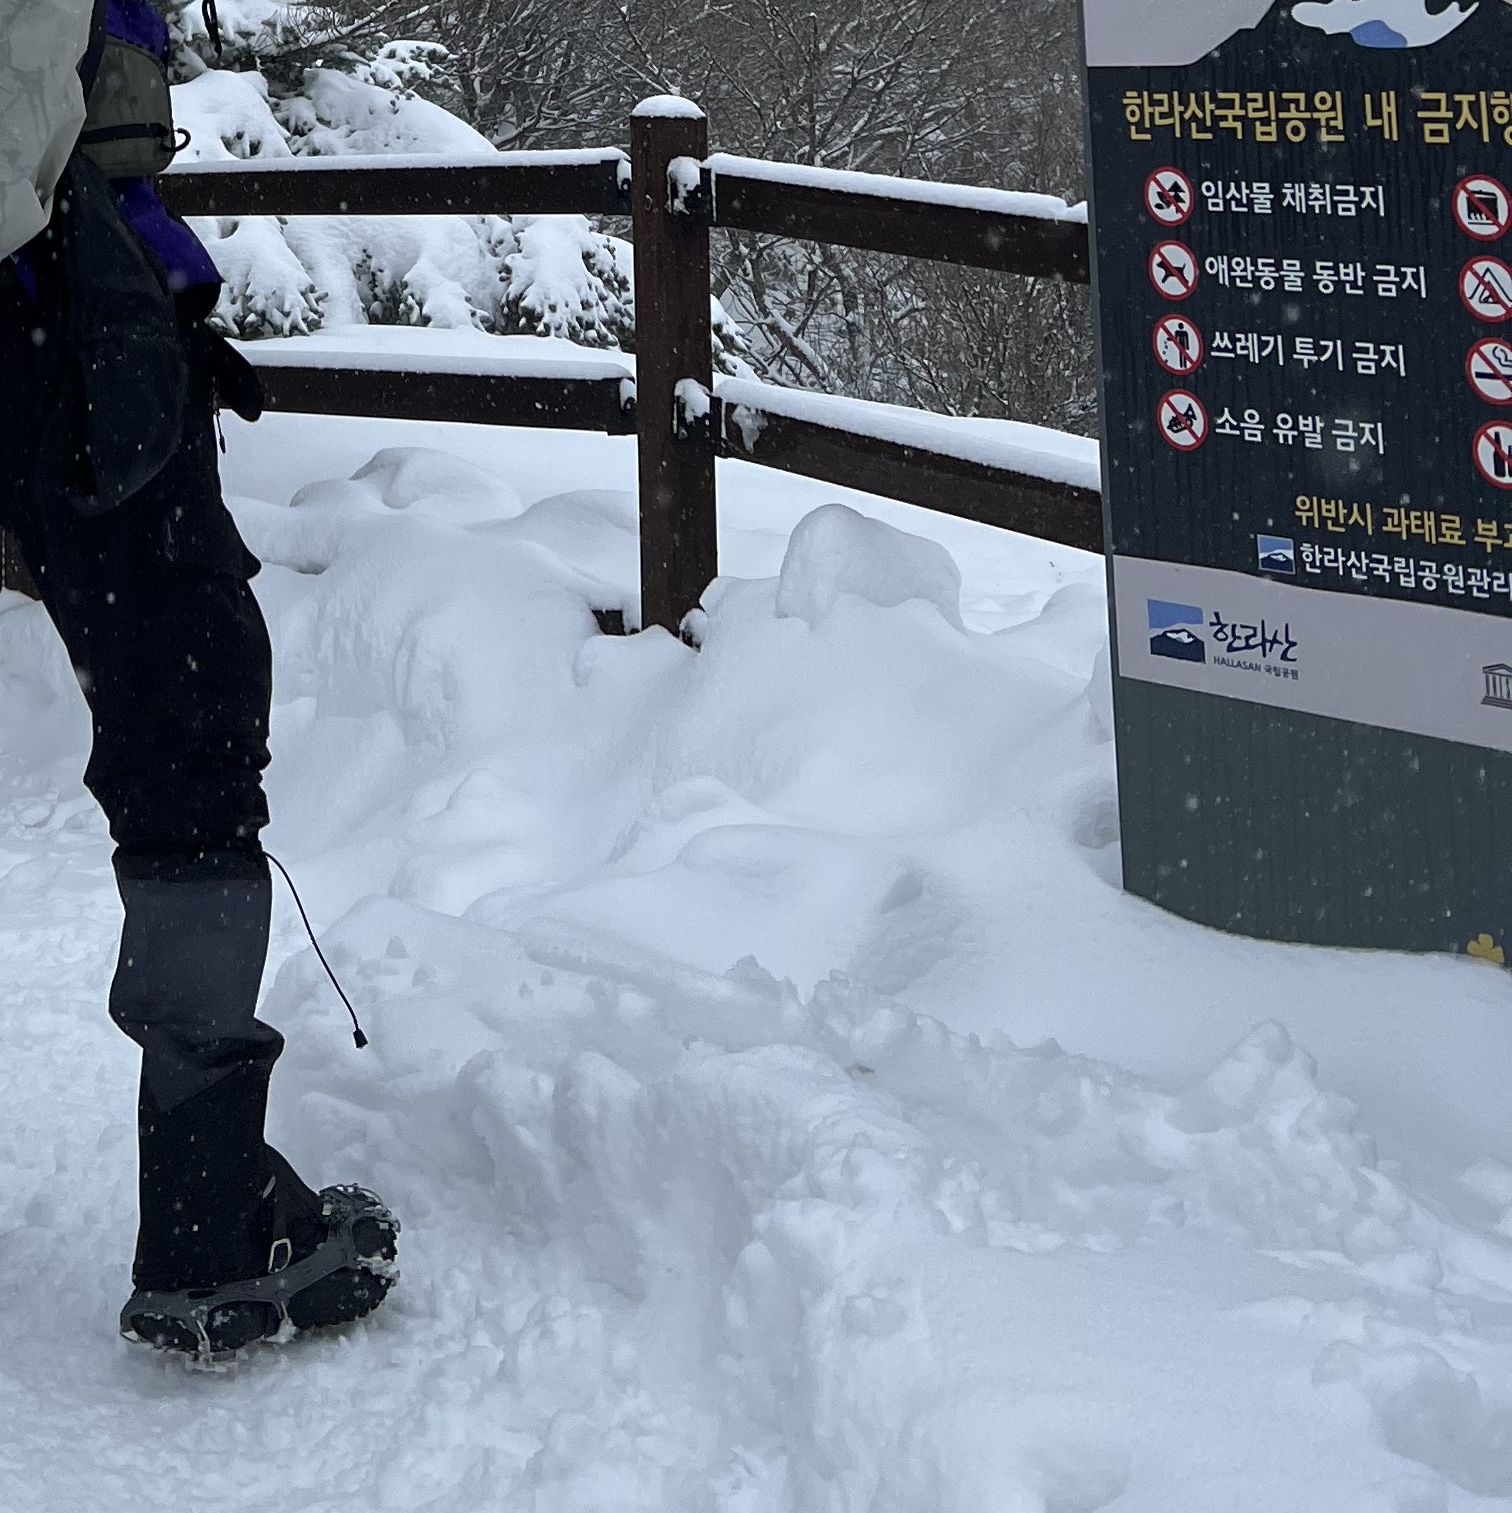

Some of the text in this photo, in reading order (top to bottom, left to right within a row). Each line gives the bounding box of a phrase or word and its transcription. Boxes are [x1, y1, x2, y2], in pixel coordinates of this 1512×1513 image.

[1123, 90, 1345, 143] 한라산국립공원
[1363, 90, 1399, 142] 내
[1201, 180, 1385, 217] 임산물 채취금지
[1204, 255, 1427, 299] 애완동물 동반 금지
[1210, 331, 1406, 377] 쓰레기 투기 금지
[1215, 407, 1385, 455] 소음 유발 금지
[1294, 495, 1373, 535] 위반시
[1382, 506, 1466, 546] 과태료
[1209, 611, 1298, 662] 한라산
[1214, 655, 1262, 672] HALLASAN
